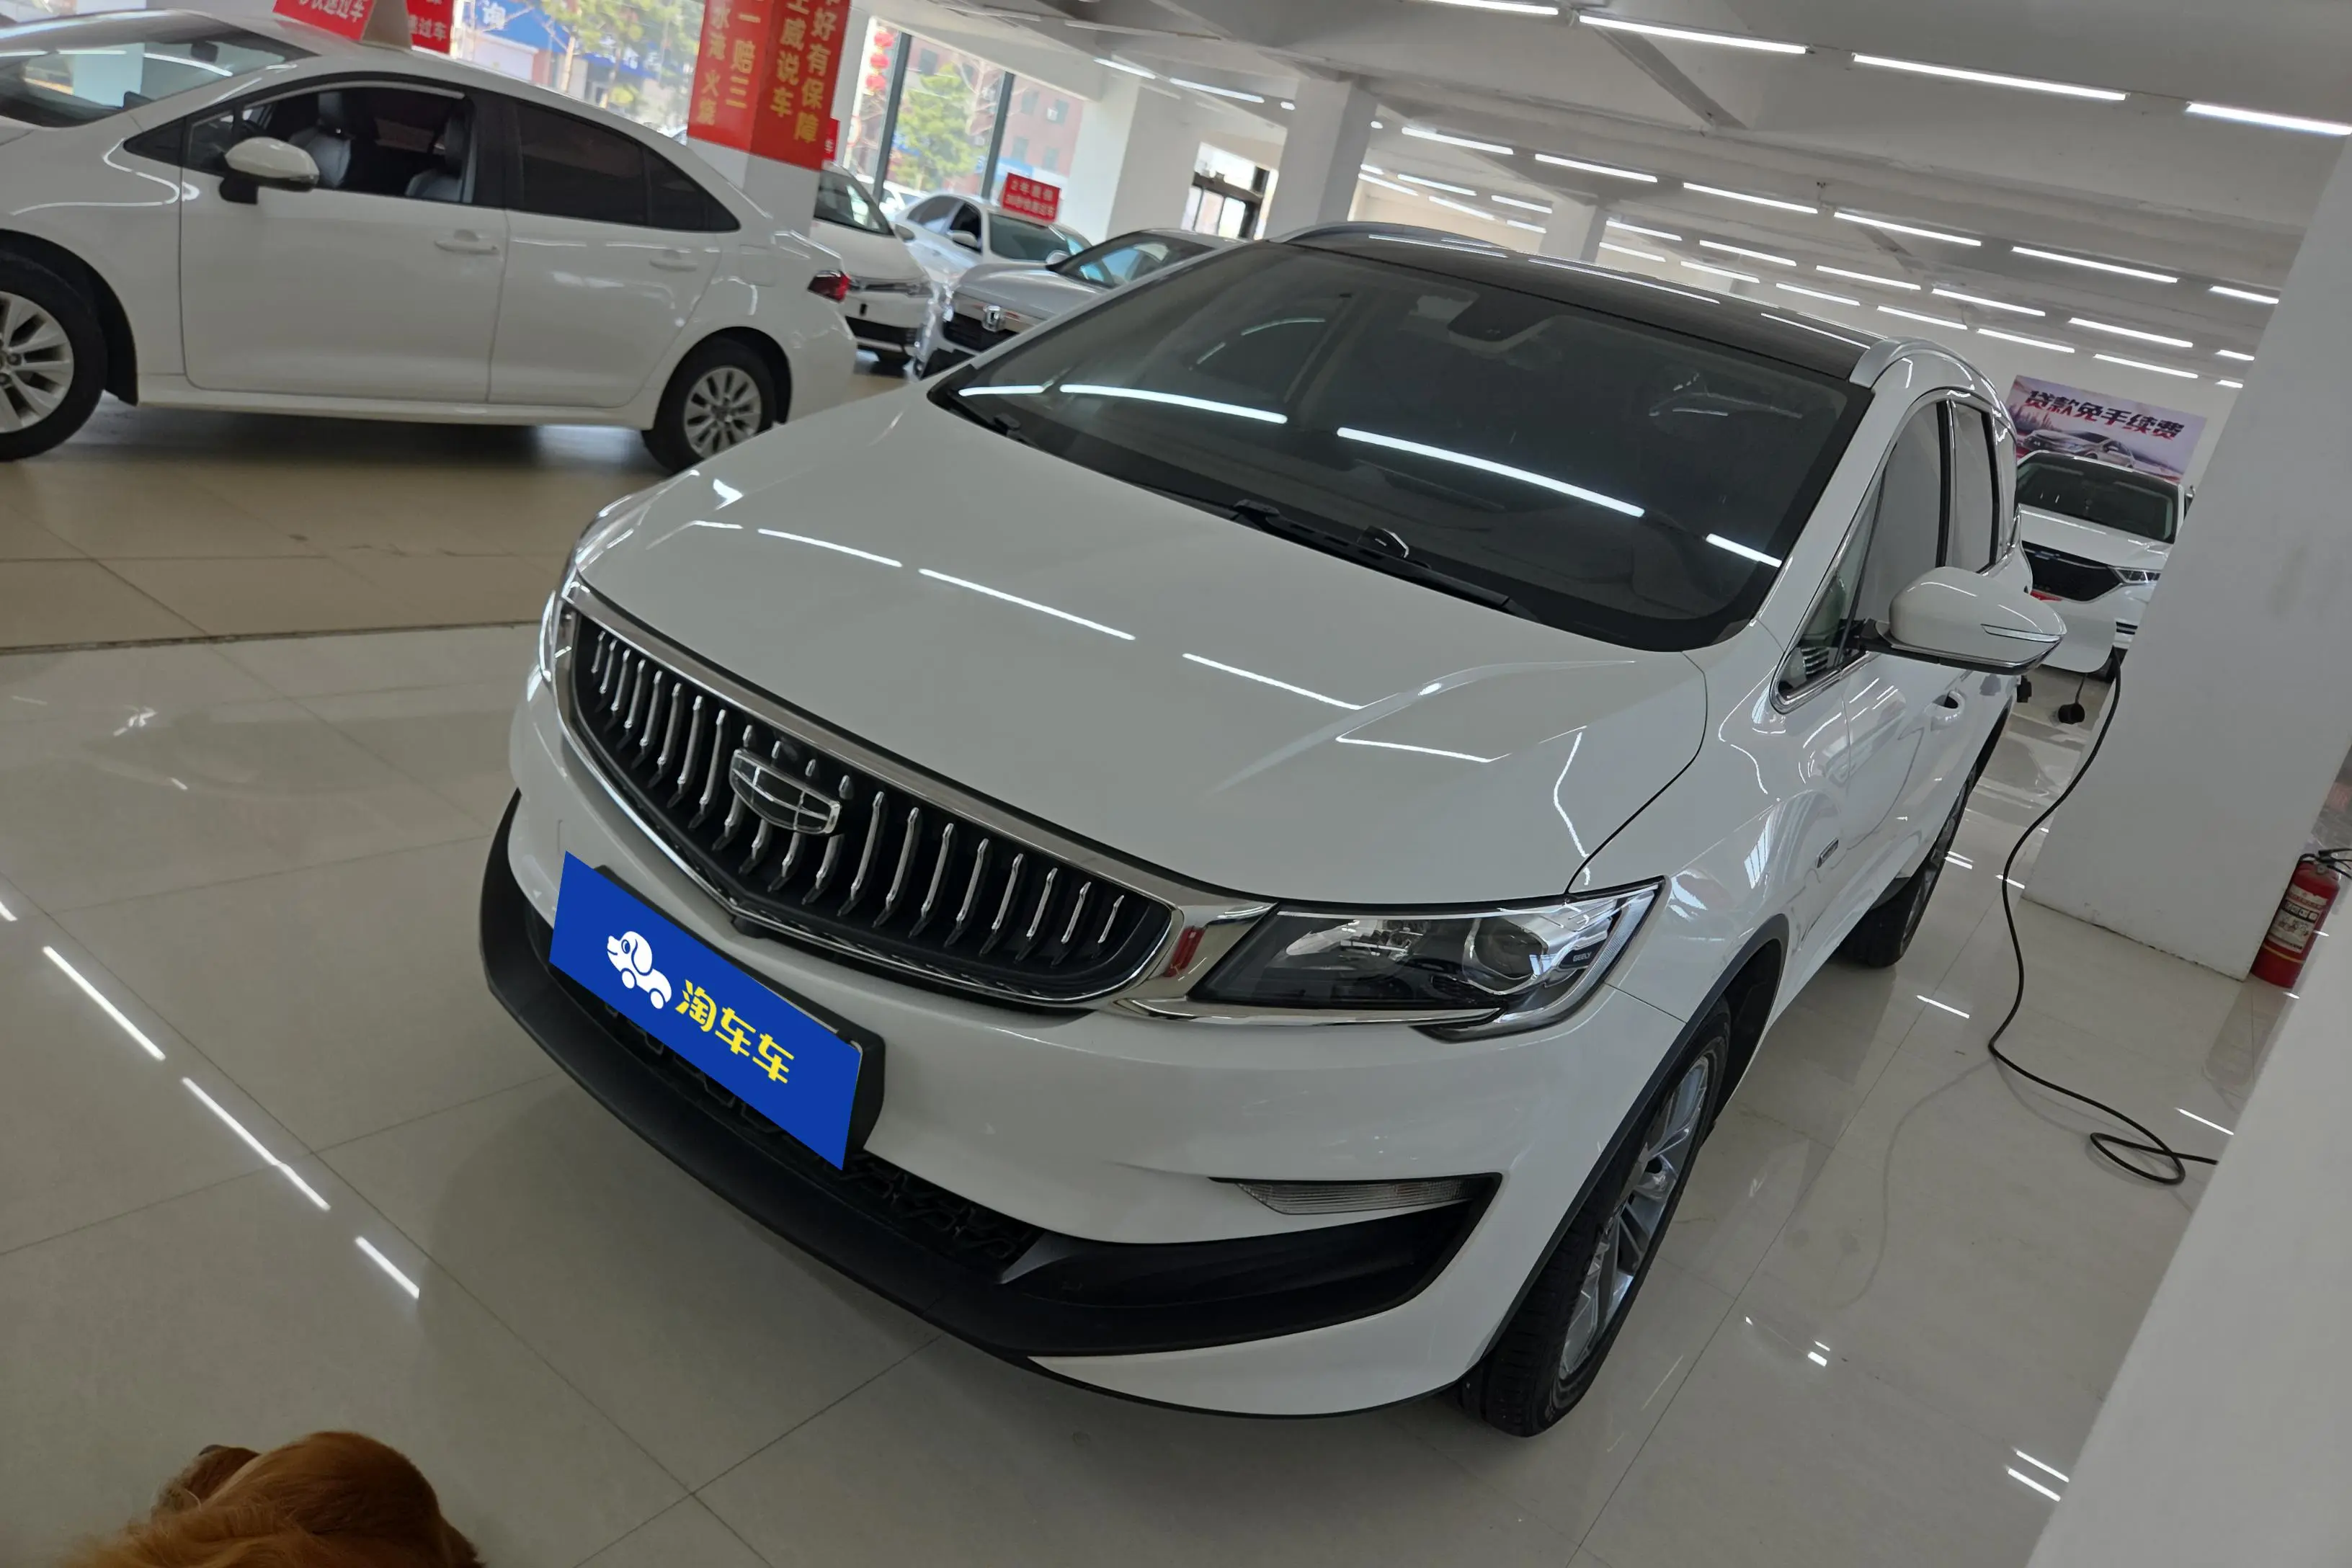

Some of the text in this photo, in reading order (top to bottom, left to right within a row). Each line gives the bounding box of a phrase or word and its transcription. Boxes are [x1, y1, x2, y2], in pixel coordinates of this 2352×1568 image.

[725, 0, 764, 109] 一赔三
[794, 0, 838, 143] 好有保障
[2025, 390, 2185, 441] 贷款免手续费
[1573, 951, 1592, 962] GEELY
